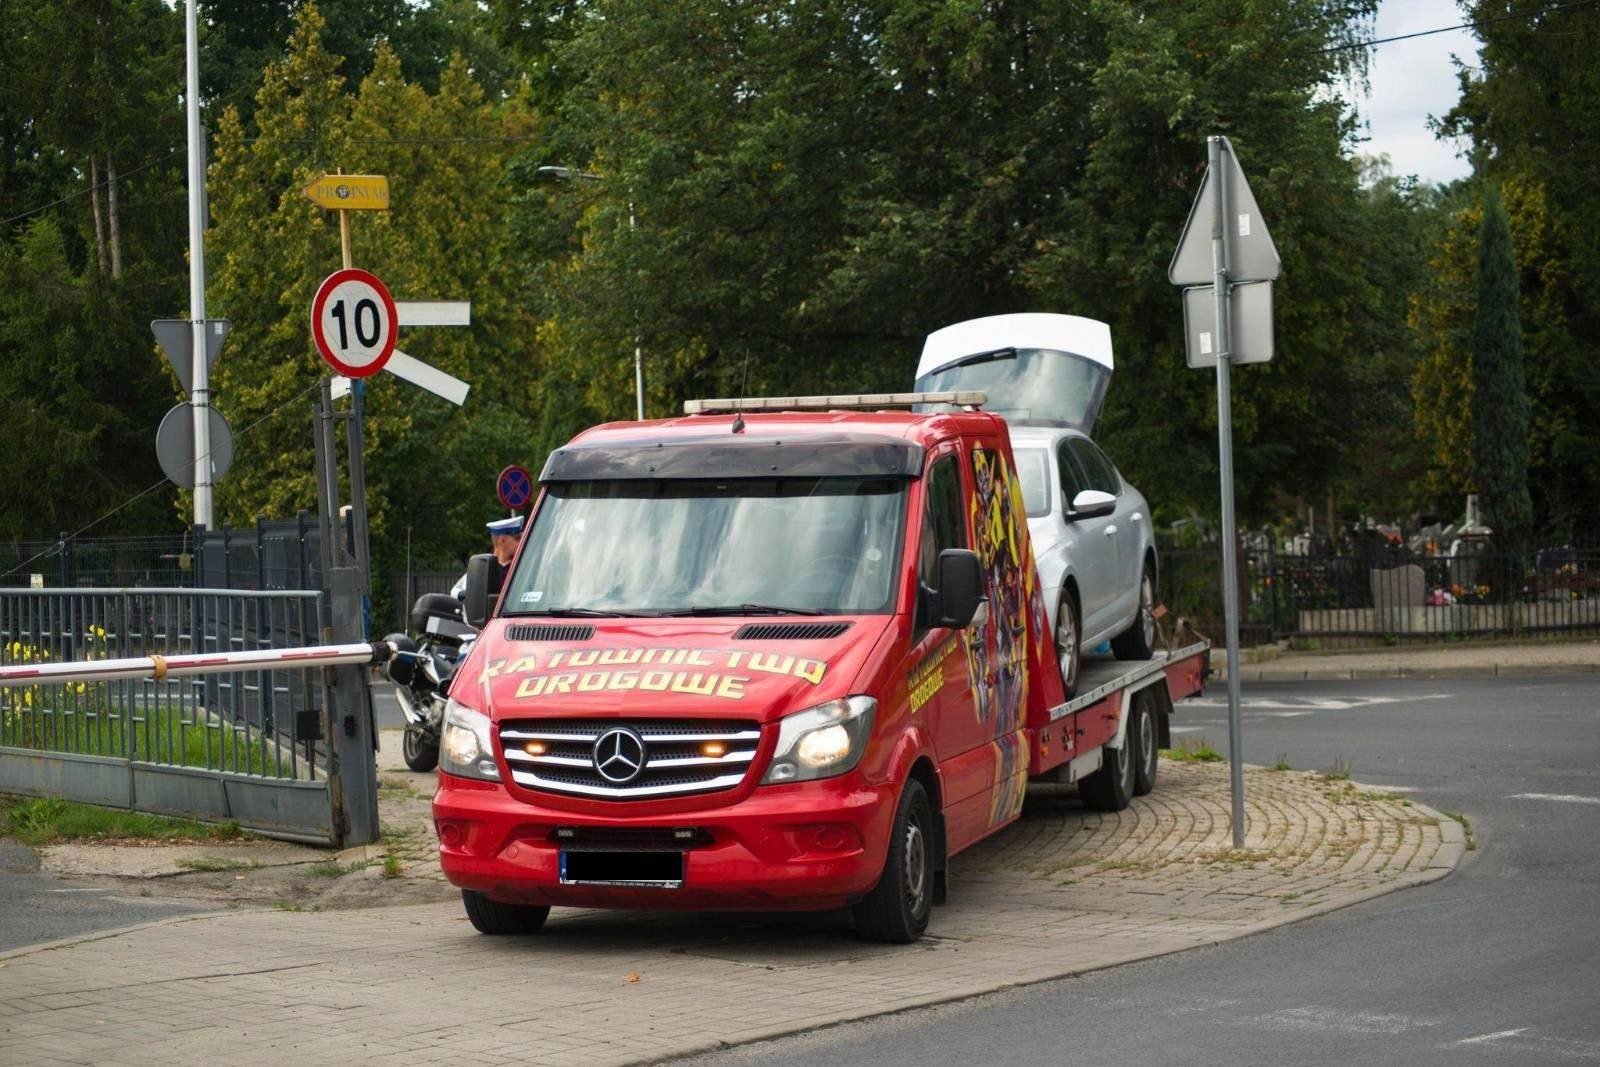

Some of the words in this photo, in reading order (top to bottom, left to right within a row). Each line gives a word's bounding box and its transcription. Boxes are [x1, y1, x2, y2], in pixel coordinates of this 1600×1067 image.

[331, 298, 381, 350] 10
[478, 648, 828, 686] RATOWNICTWO
[514, 671, 752, 700] DROGOWE
[909, 666, 944, 714] DROGOWE
